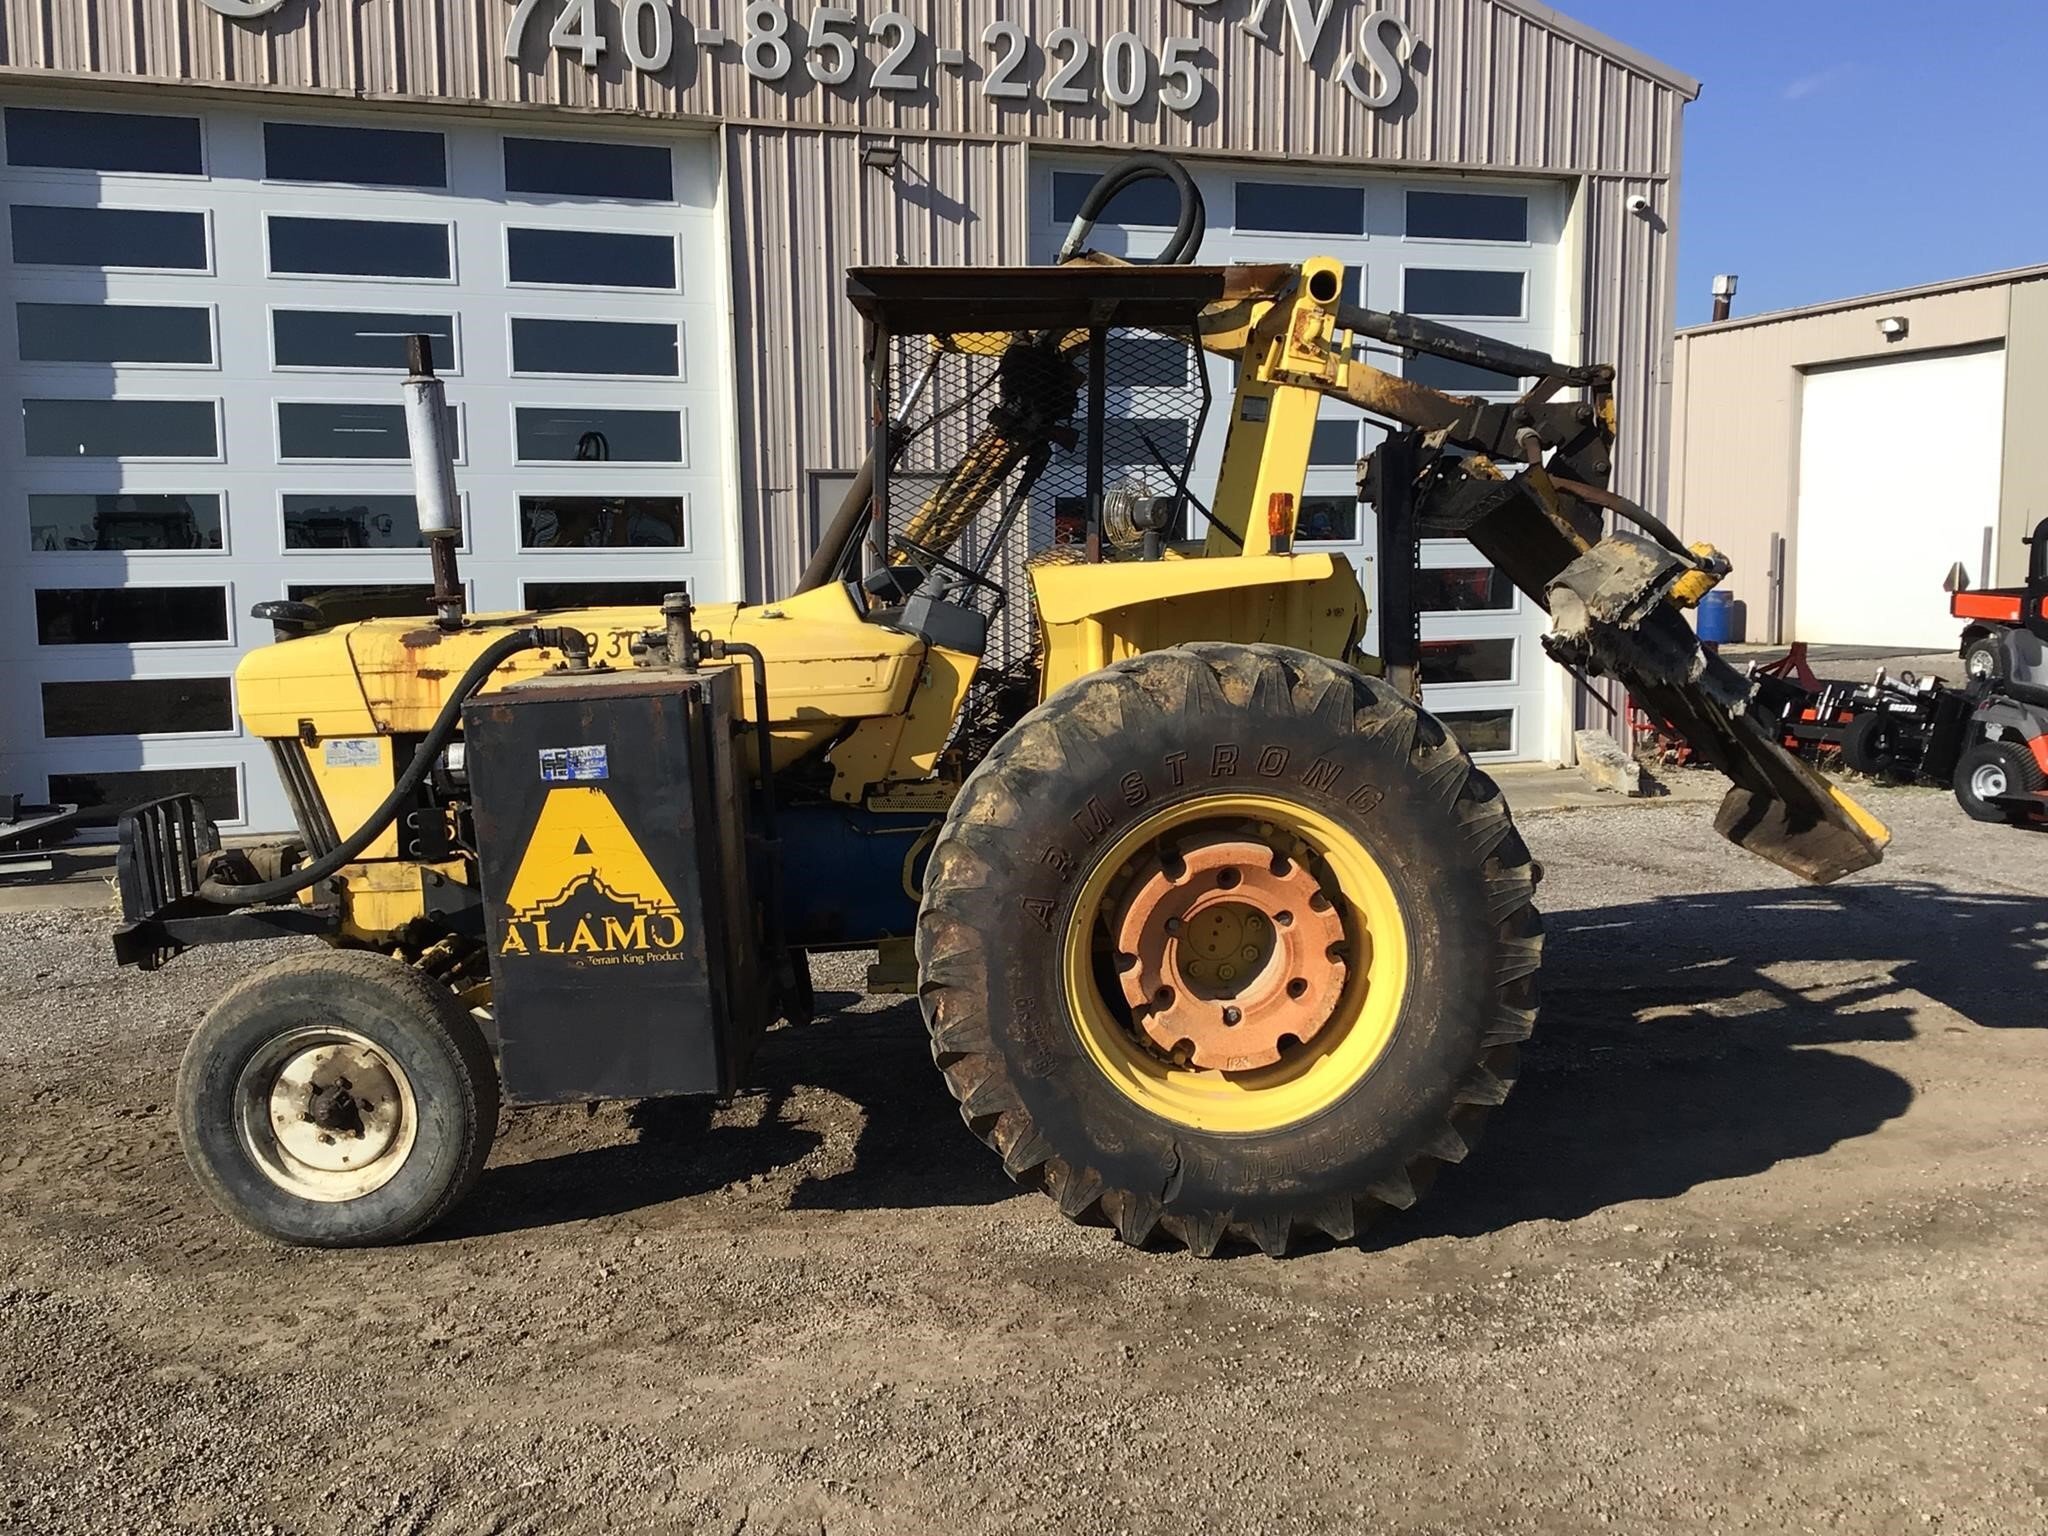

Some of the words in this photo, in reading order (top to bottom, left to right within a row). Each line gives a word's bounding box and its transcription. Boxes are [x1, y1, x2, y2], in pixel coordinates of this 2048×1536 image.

[504, 0, 1203, 110] 740-852-2205
[1181, 0, 1419, 108] NS
[1020, 743, 1385, 931] ARMSTRONG
[501, 912, 685, 957] ALAMO
[622, 953, 644, 965] King
[646, 951, 684, 962] Product
